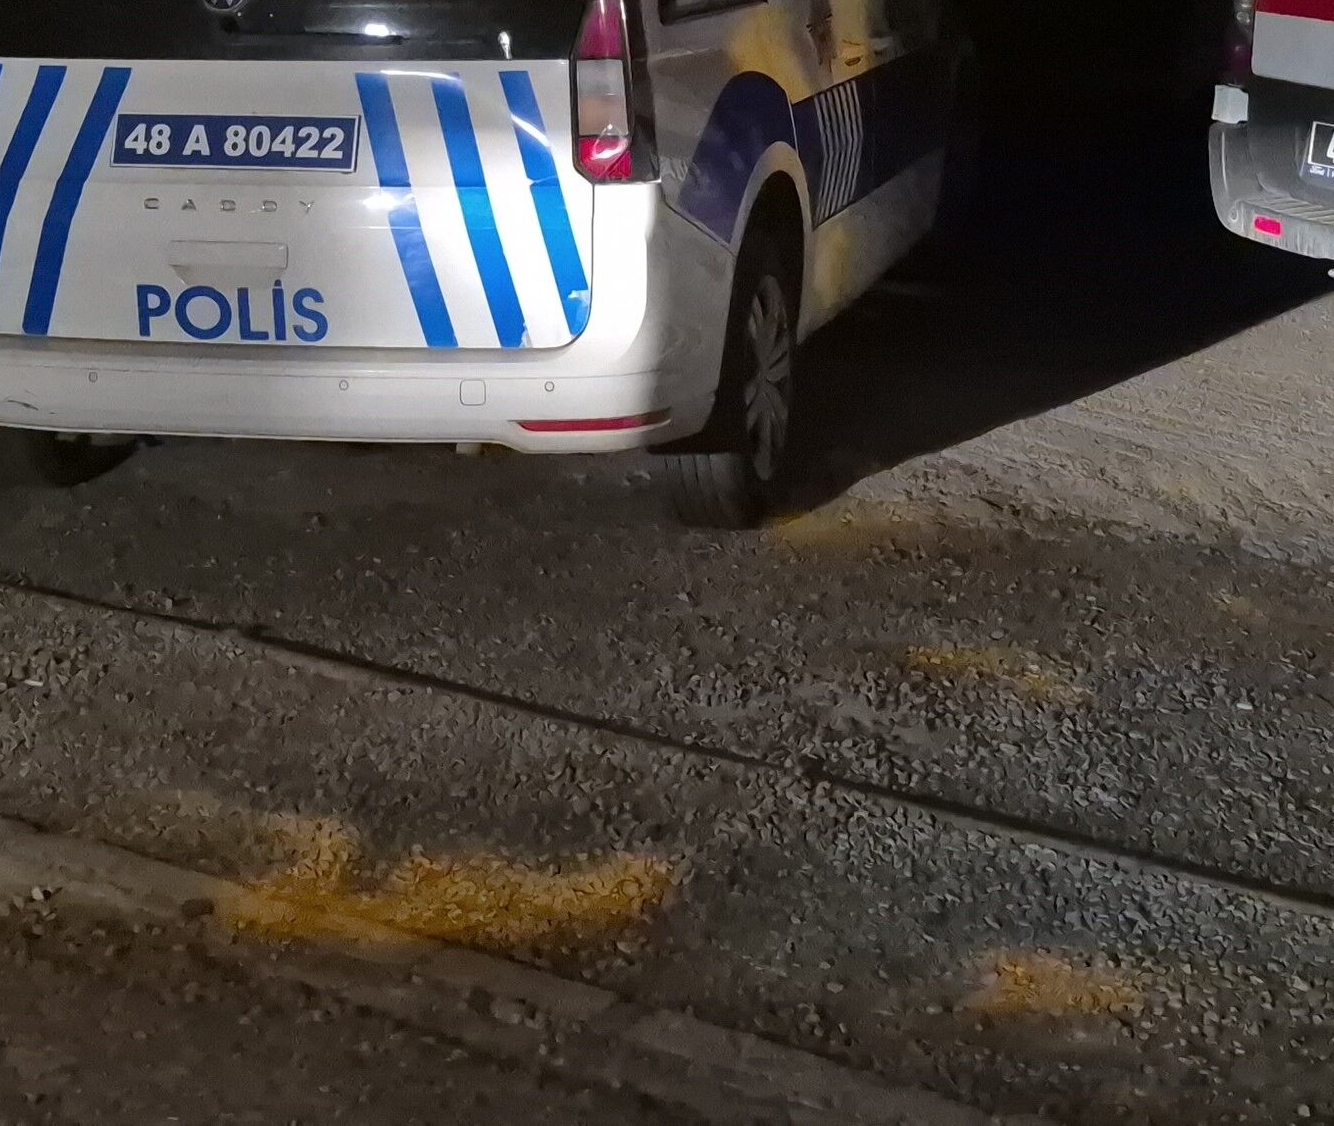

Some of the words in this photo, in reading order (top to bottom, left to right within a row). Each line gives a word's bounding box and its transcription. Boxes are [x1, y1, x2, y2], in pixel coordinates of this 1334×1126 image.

[124, 123, 172, 156] 48
[182, 124, 211, 156] A
[223, 125, 345, 159] 80422
[143, 197, 316, 214] CADDY
[135, 279, 329, 342] POLİS
